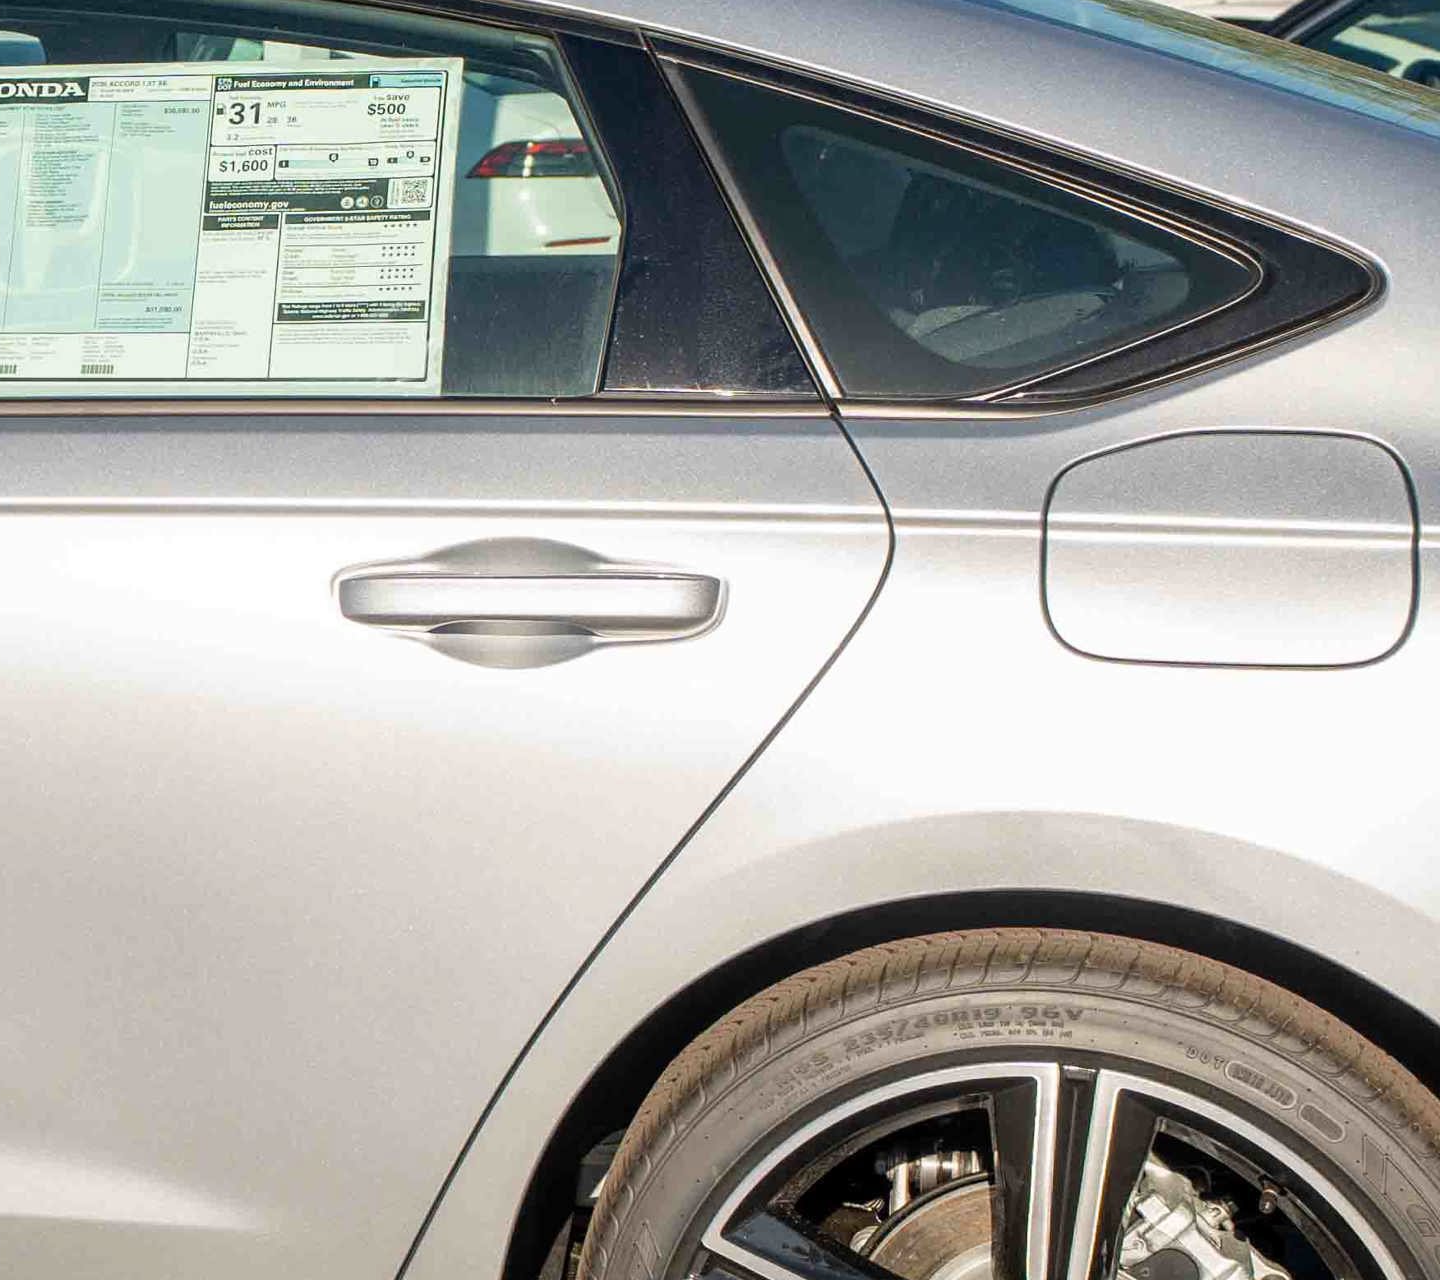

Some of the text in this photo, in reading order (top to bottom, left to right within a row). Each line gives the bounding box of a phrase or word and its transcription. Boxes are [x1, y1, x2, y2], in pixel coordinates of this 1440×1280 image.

[251, 80, 287, 89] Economy
[288, 79, 303, 87] and
[304, 79, 354, 87] Environment
[229, 102, 261, 125] 31
[367, 103, 406, 115] $500
[248, 147, 273, 156] cost
[219, 160, 268, 173] $1,600
[209, 200, 289, 210] fueleconomy.gov
